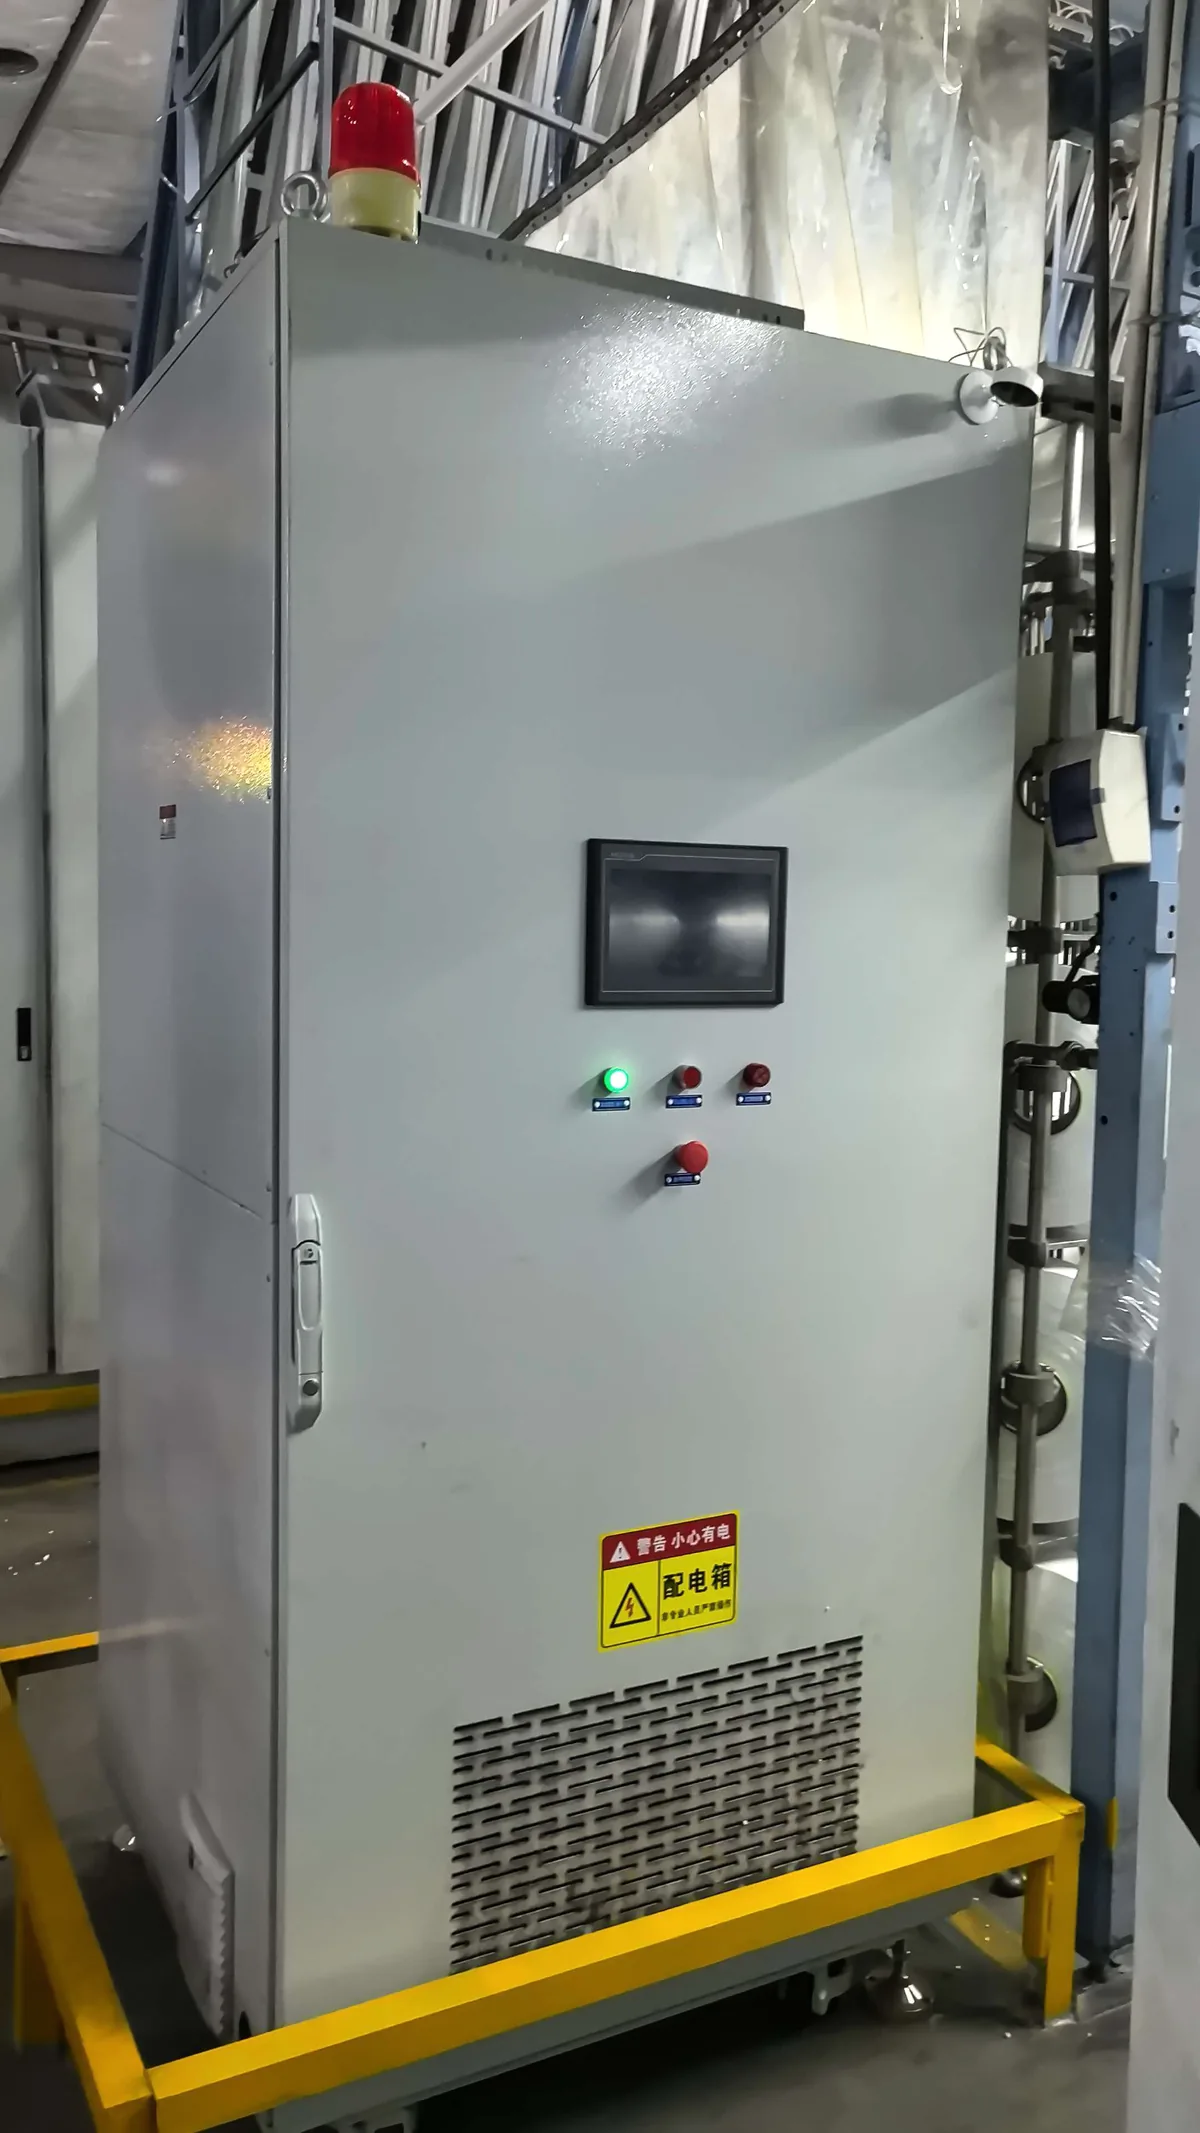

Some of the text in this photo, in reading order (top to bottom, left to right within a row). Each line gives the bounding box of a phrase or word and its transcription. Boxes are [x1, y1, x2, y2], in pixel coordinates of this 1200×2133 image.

[637, 1523, 731, 1556] 警告 小心有电
[662, 1562, 732, 1600] 配电箱
